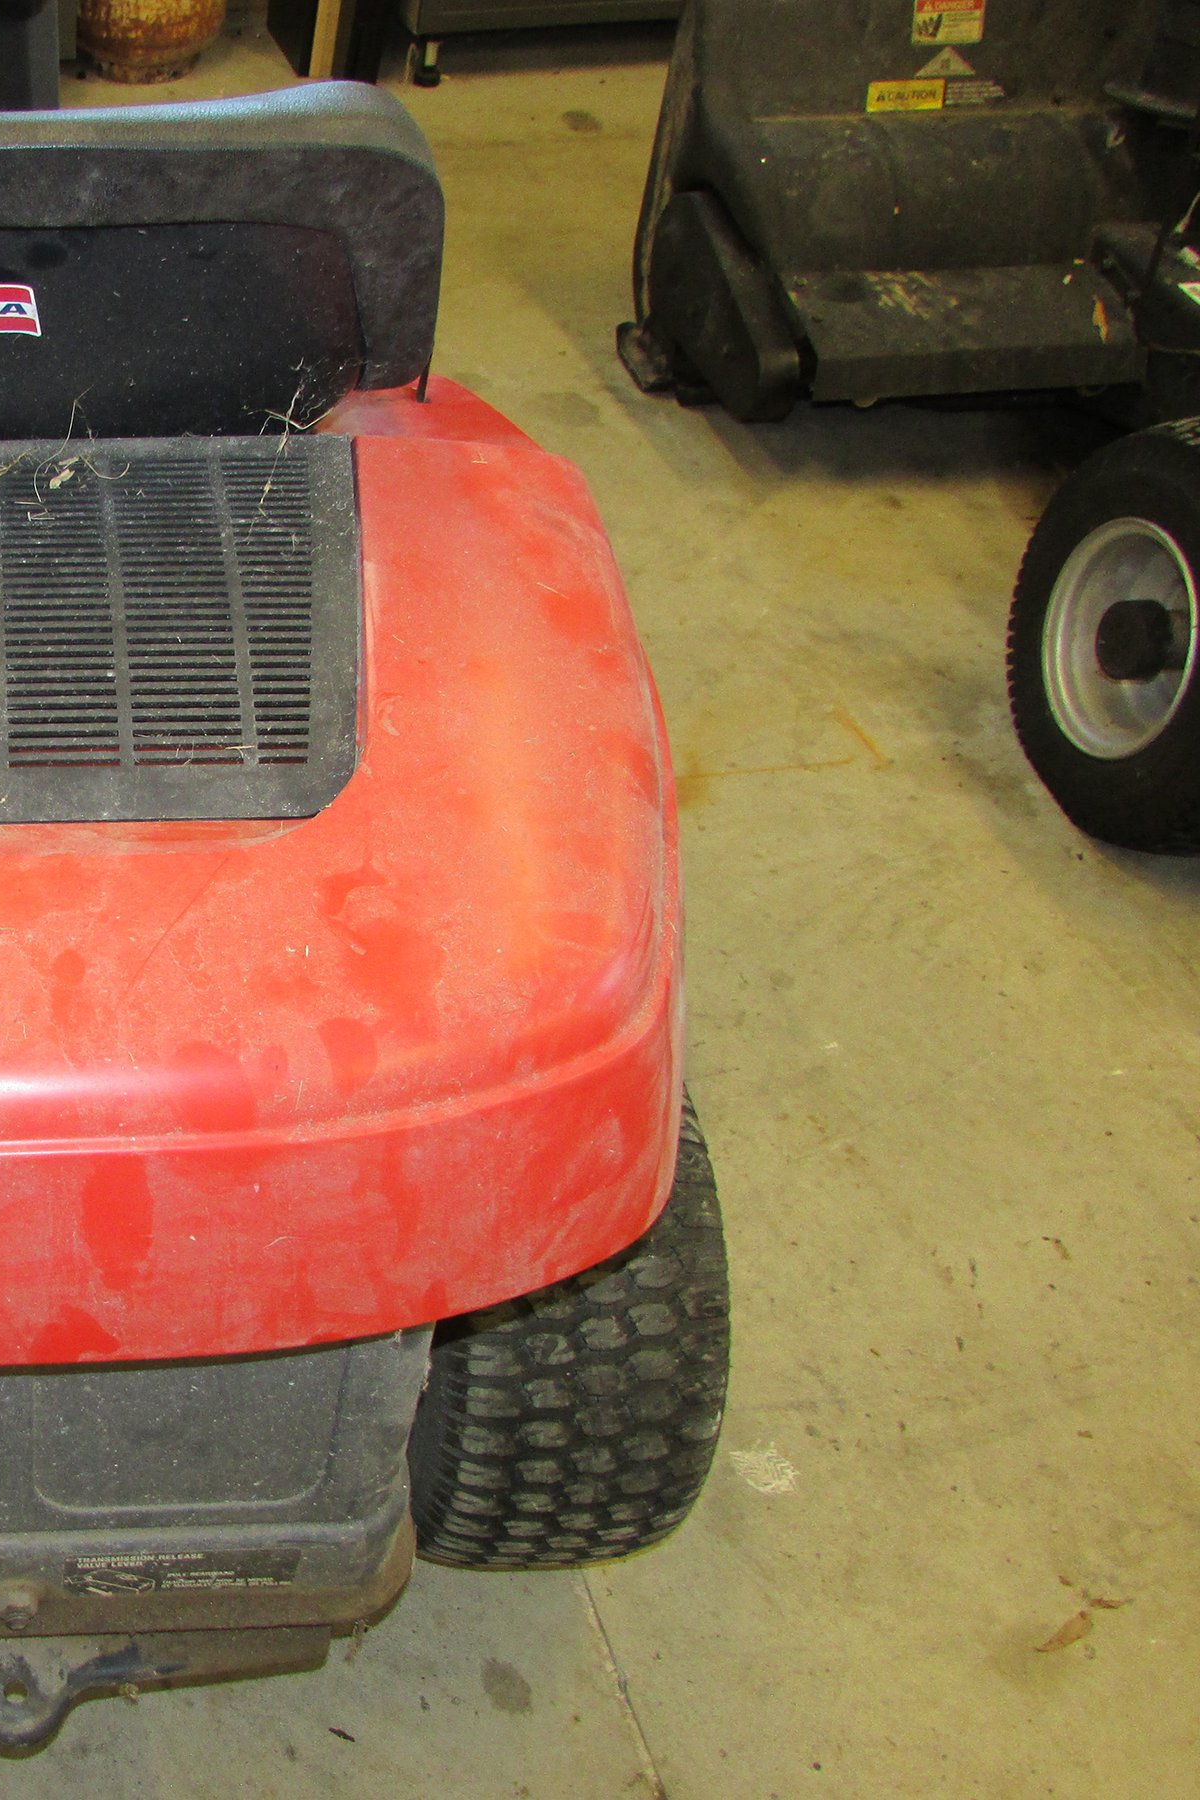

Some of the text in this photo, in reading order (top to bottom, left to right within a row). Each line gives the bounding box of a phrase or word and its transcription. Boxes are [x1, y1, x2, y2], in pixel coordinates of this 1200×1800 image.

[888, 90, 937, 101] CAUTION
[77, 1553, 205, 1563] TRANSMISSION RELEASE
